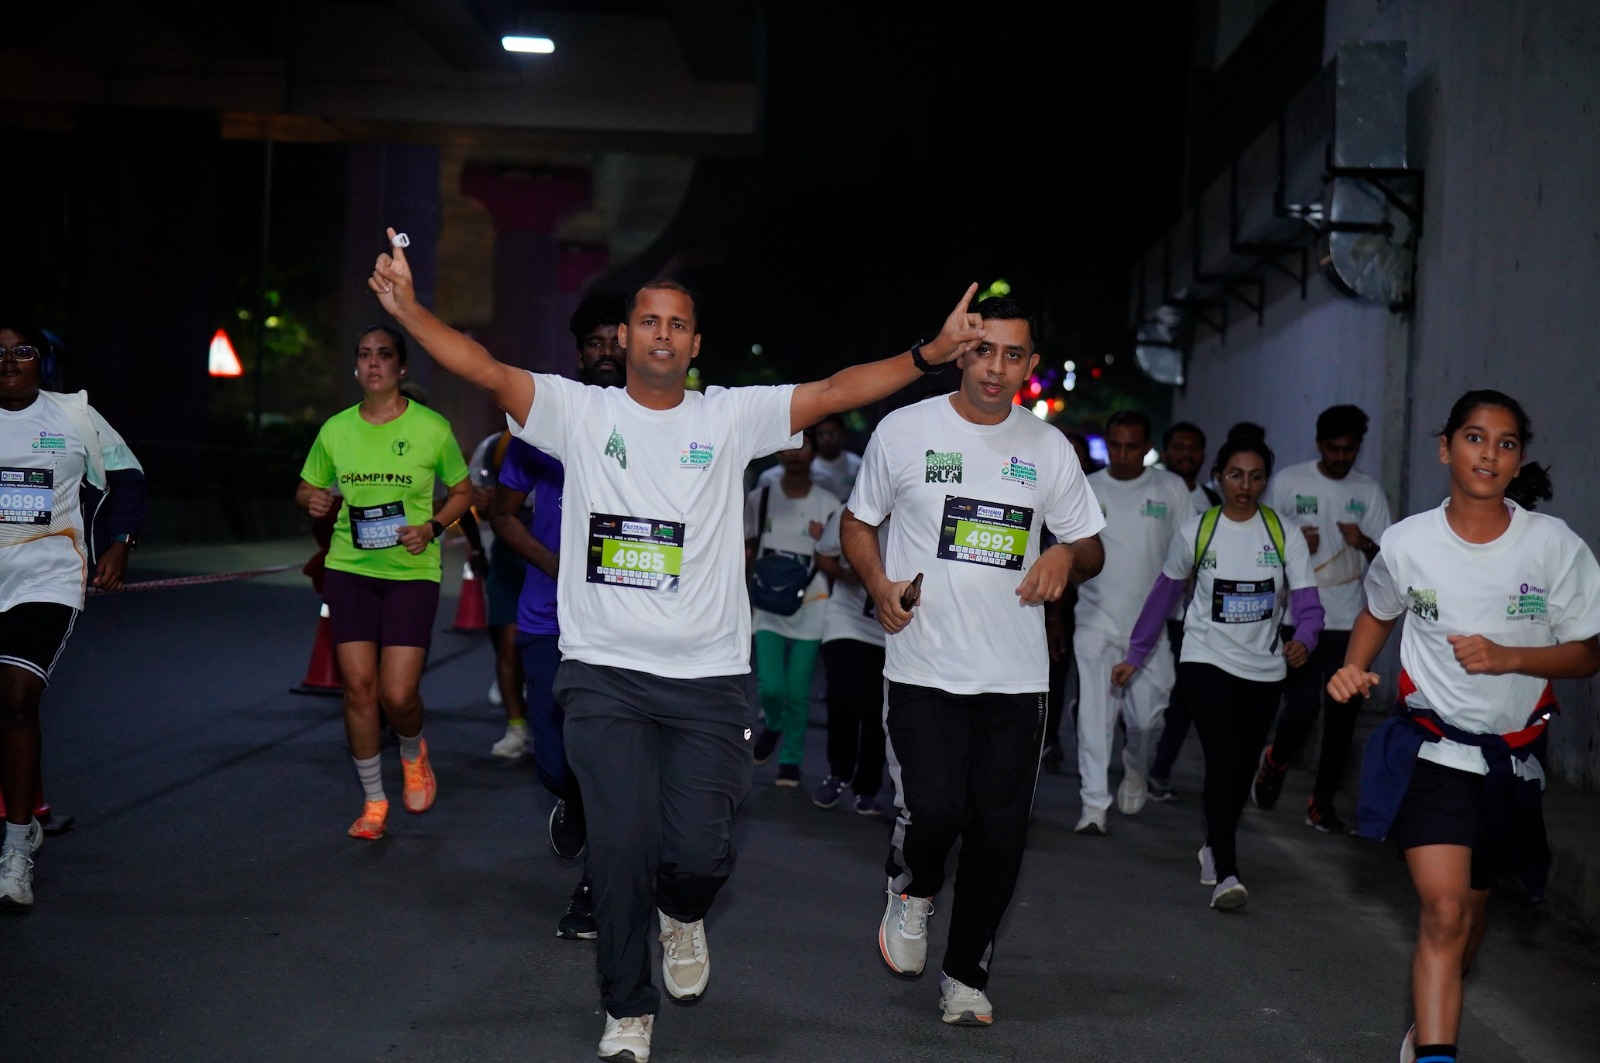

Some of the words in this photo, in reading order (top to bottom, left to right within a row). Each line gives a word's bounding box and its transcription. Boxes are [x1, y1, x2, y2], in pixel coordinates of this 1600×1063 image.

[926, 464, 962, 472] HONOUR
[925, 471, 962, 483] RUN
[966, 529, 1014, 551] 4992
[612, 549, 664, 571] 4985
